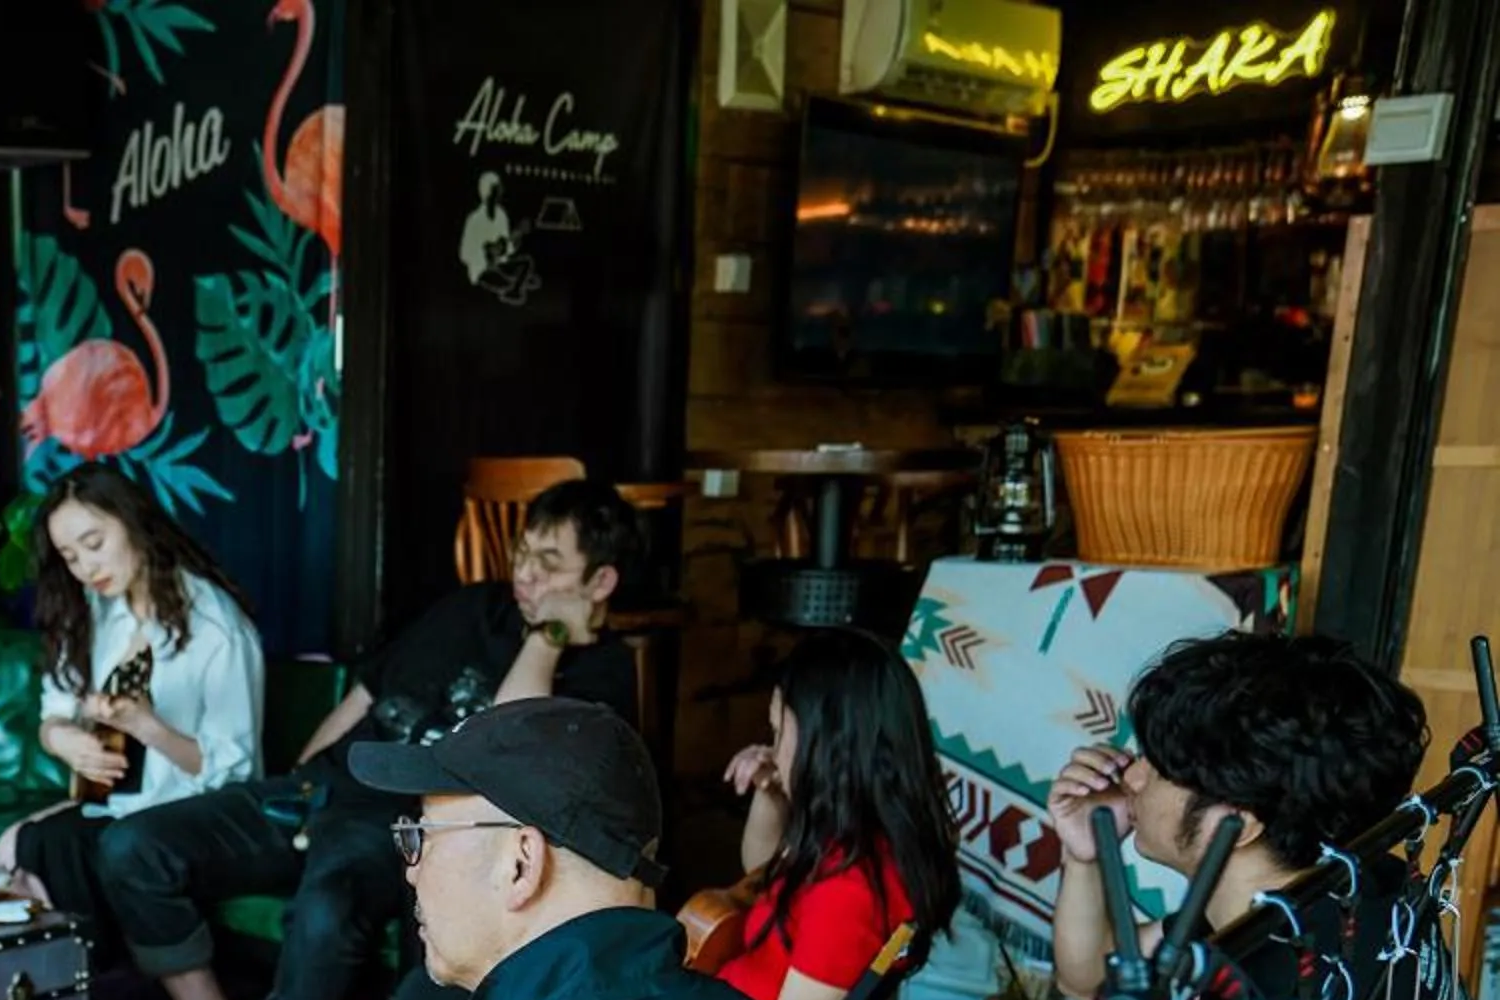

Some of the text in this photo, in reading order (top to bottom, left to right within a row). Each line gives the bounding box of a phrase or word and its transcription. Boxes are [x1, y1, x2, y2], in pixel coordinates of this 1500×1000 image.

[1089, 10, 1333, 112] SHAKA
[110, 101, 232, 225] Aloha
[452, 75, 619, 179] Aloha Camp
